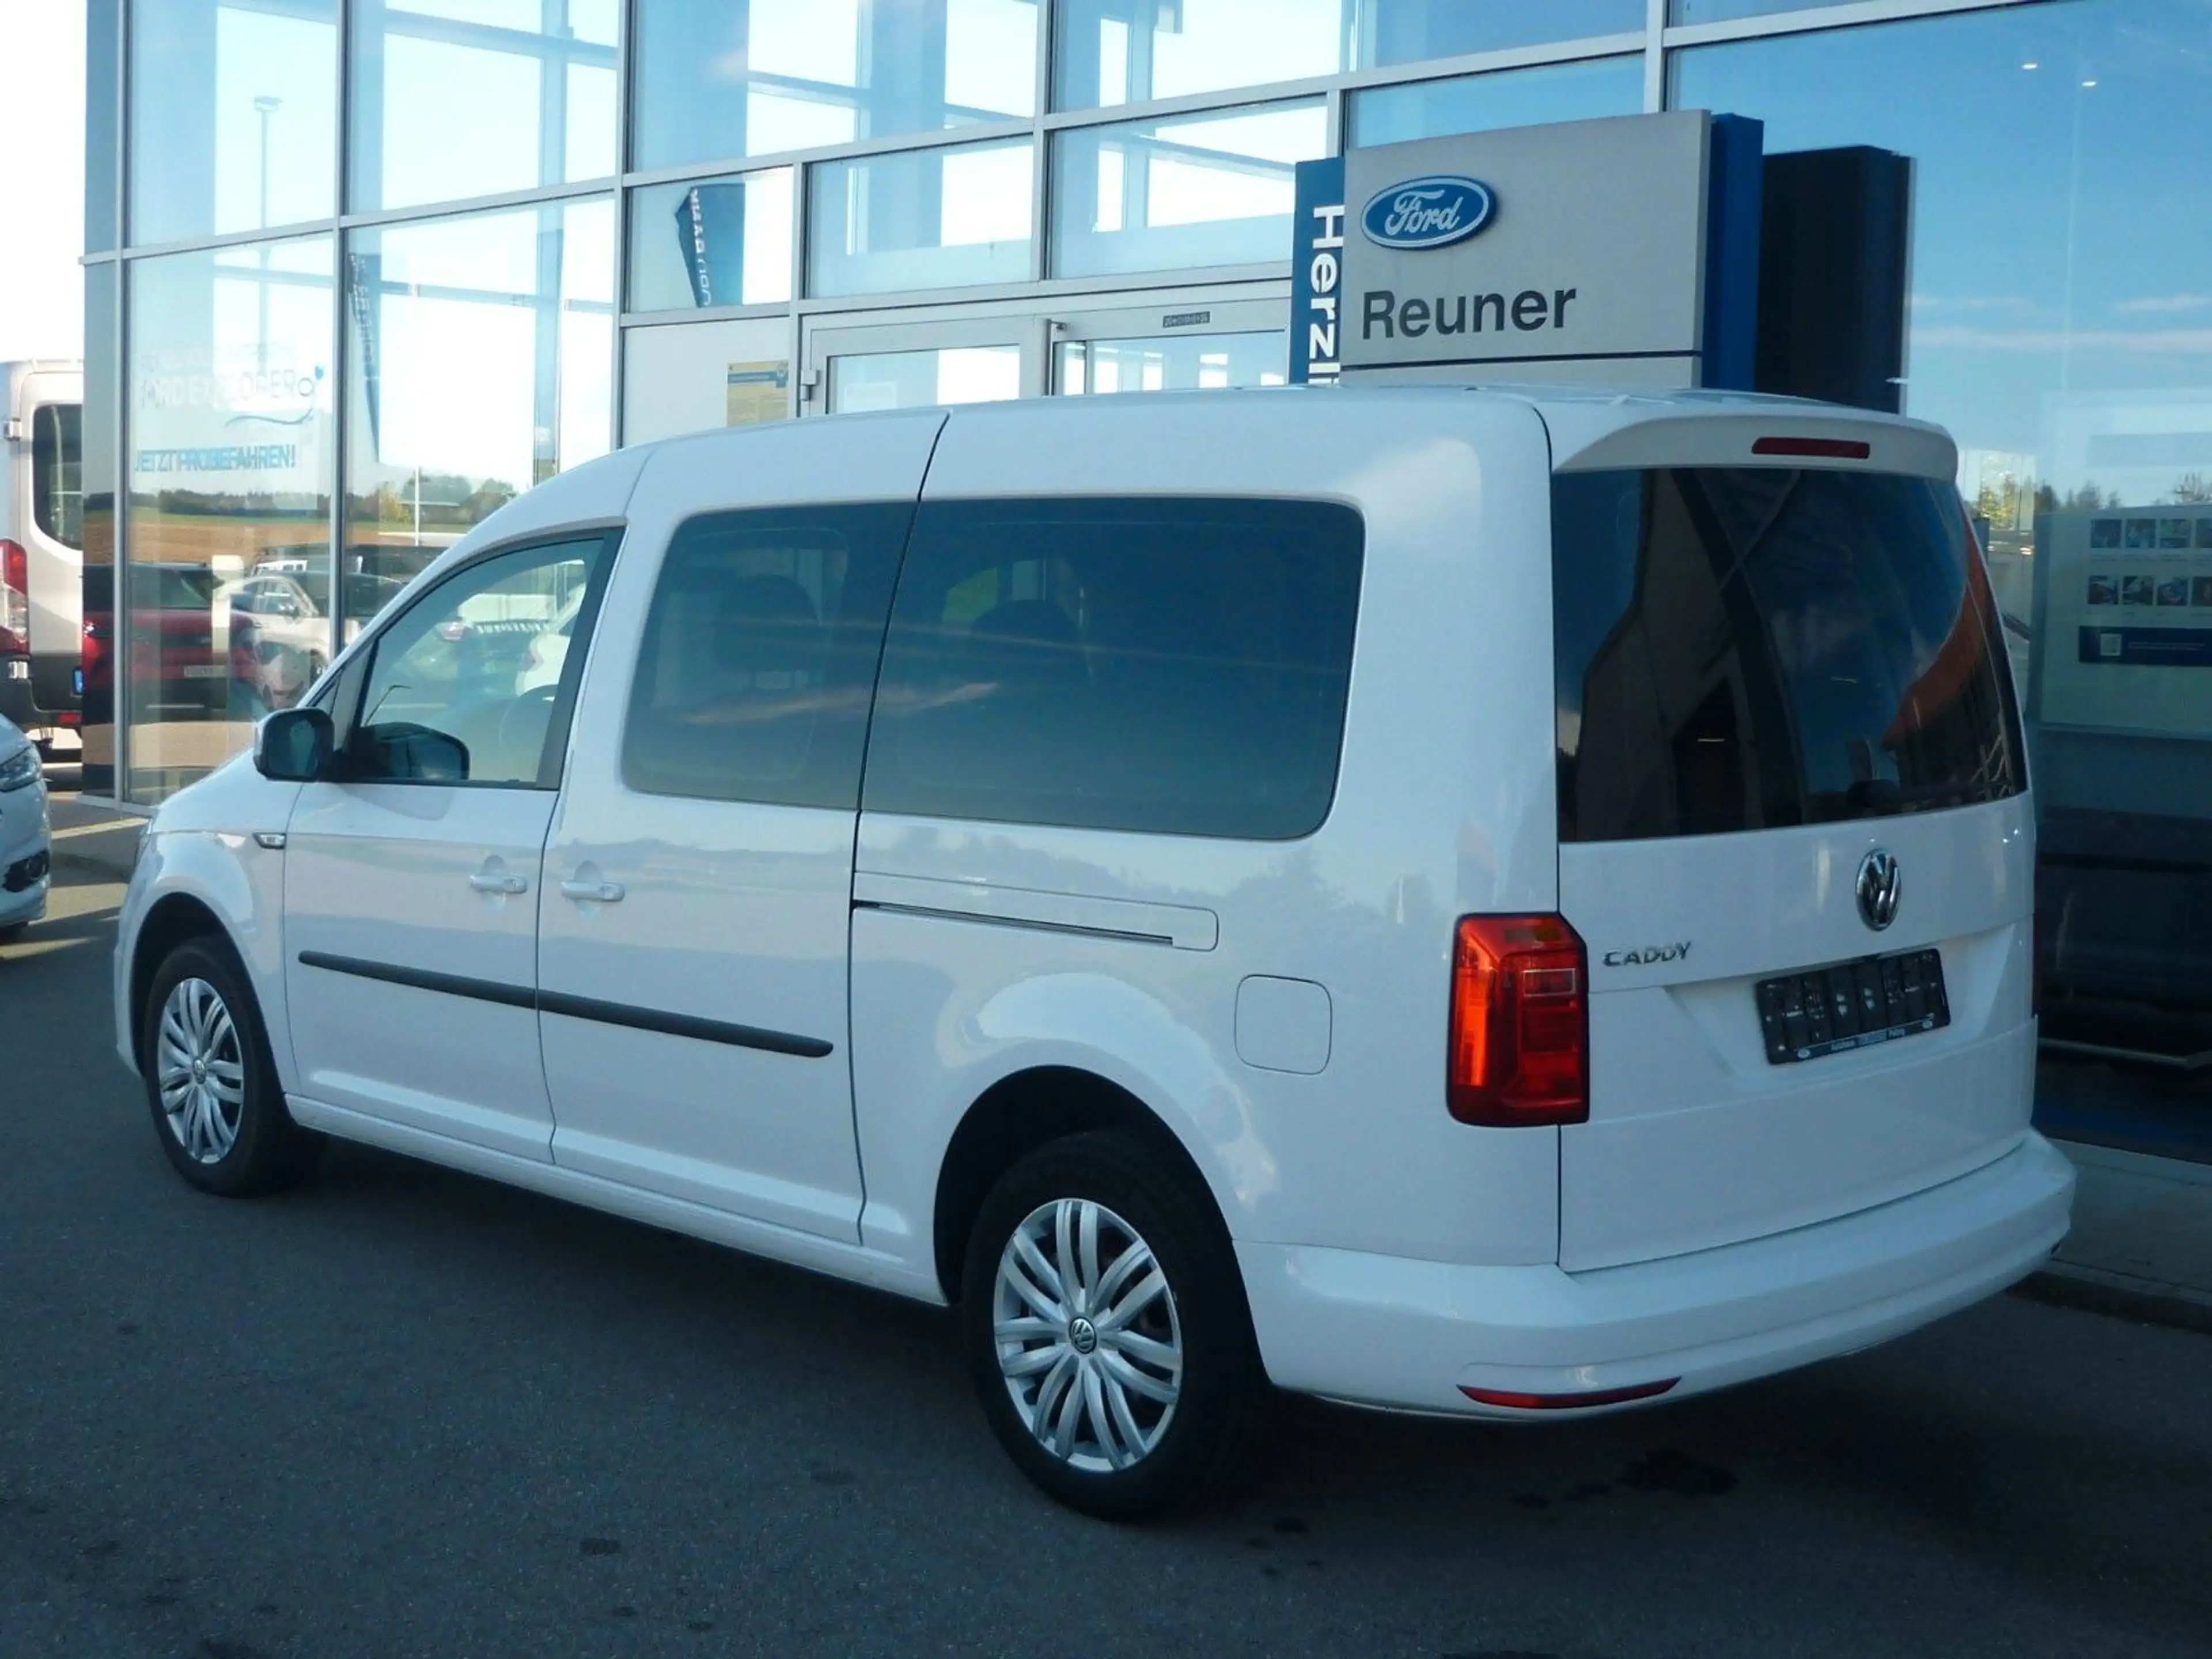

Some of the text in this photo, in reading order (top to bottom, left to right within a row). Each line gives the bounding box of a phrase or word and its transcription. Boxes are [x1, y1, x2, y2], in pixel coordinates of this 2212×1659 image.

[1384, 189, 1464, 236] Ford
[1363, 288, 1577, 339] Reuner
[135, 448, 178, 472] JETZT
[1603, 941, 1692, 967] CADDY
